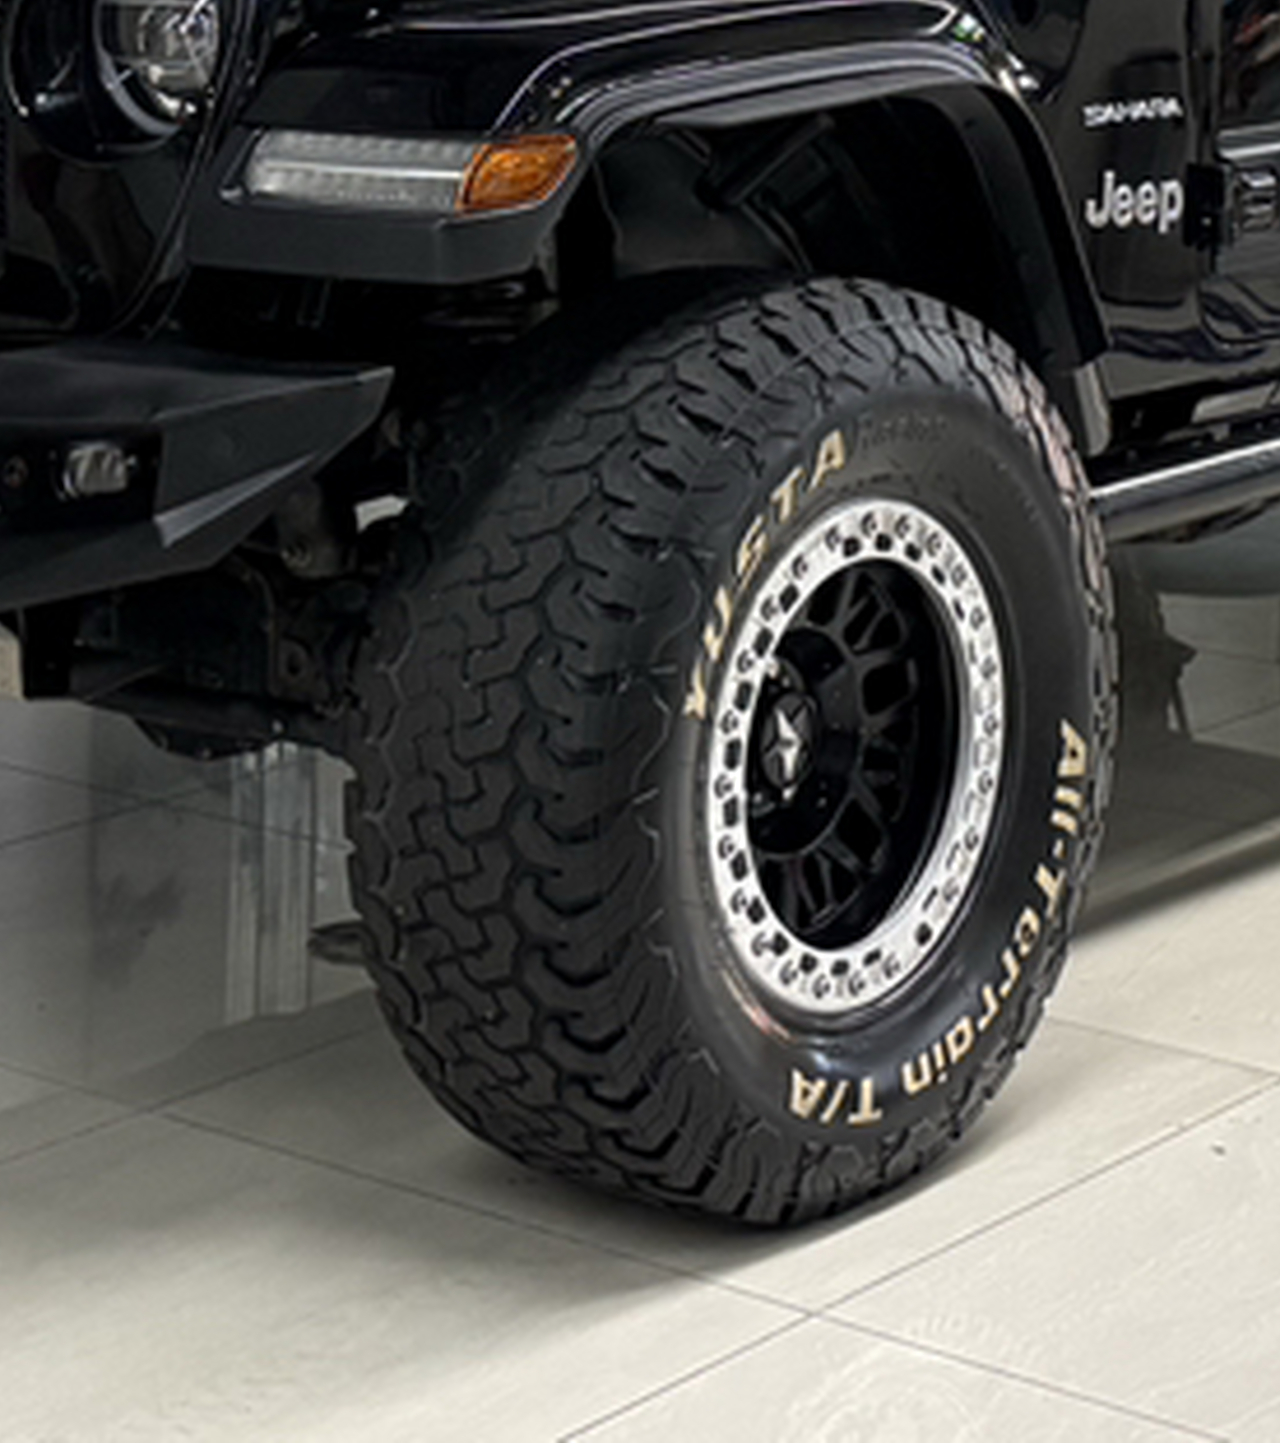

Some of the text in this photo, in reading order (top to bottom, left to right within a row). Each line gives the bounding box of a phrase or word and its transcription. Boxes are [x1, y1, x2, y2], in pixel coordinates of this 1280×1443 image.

[1084, 170, 1184, 235] Jeep
[789, 718, 1088, 1126] All-Terrain T/A
